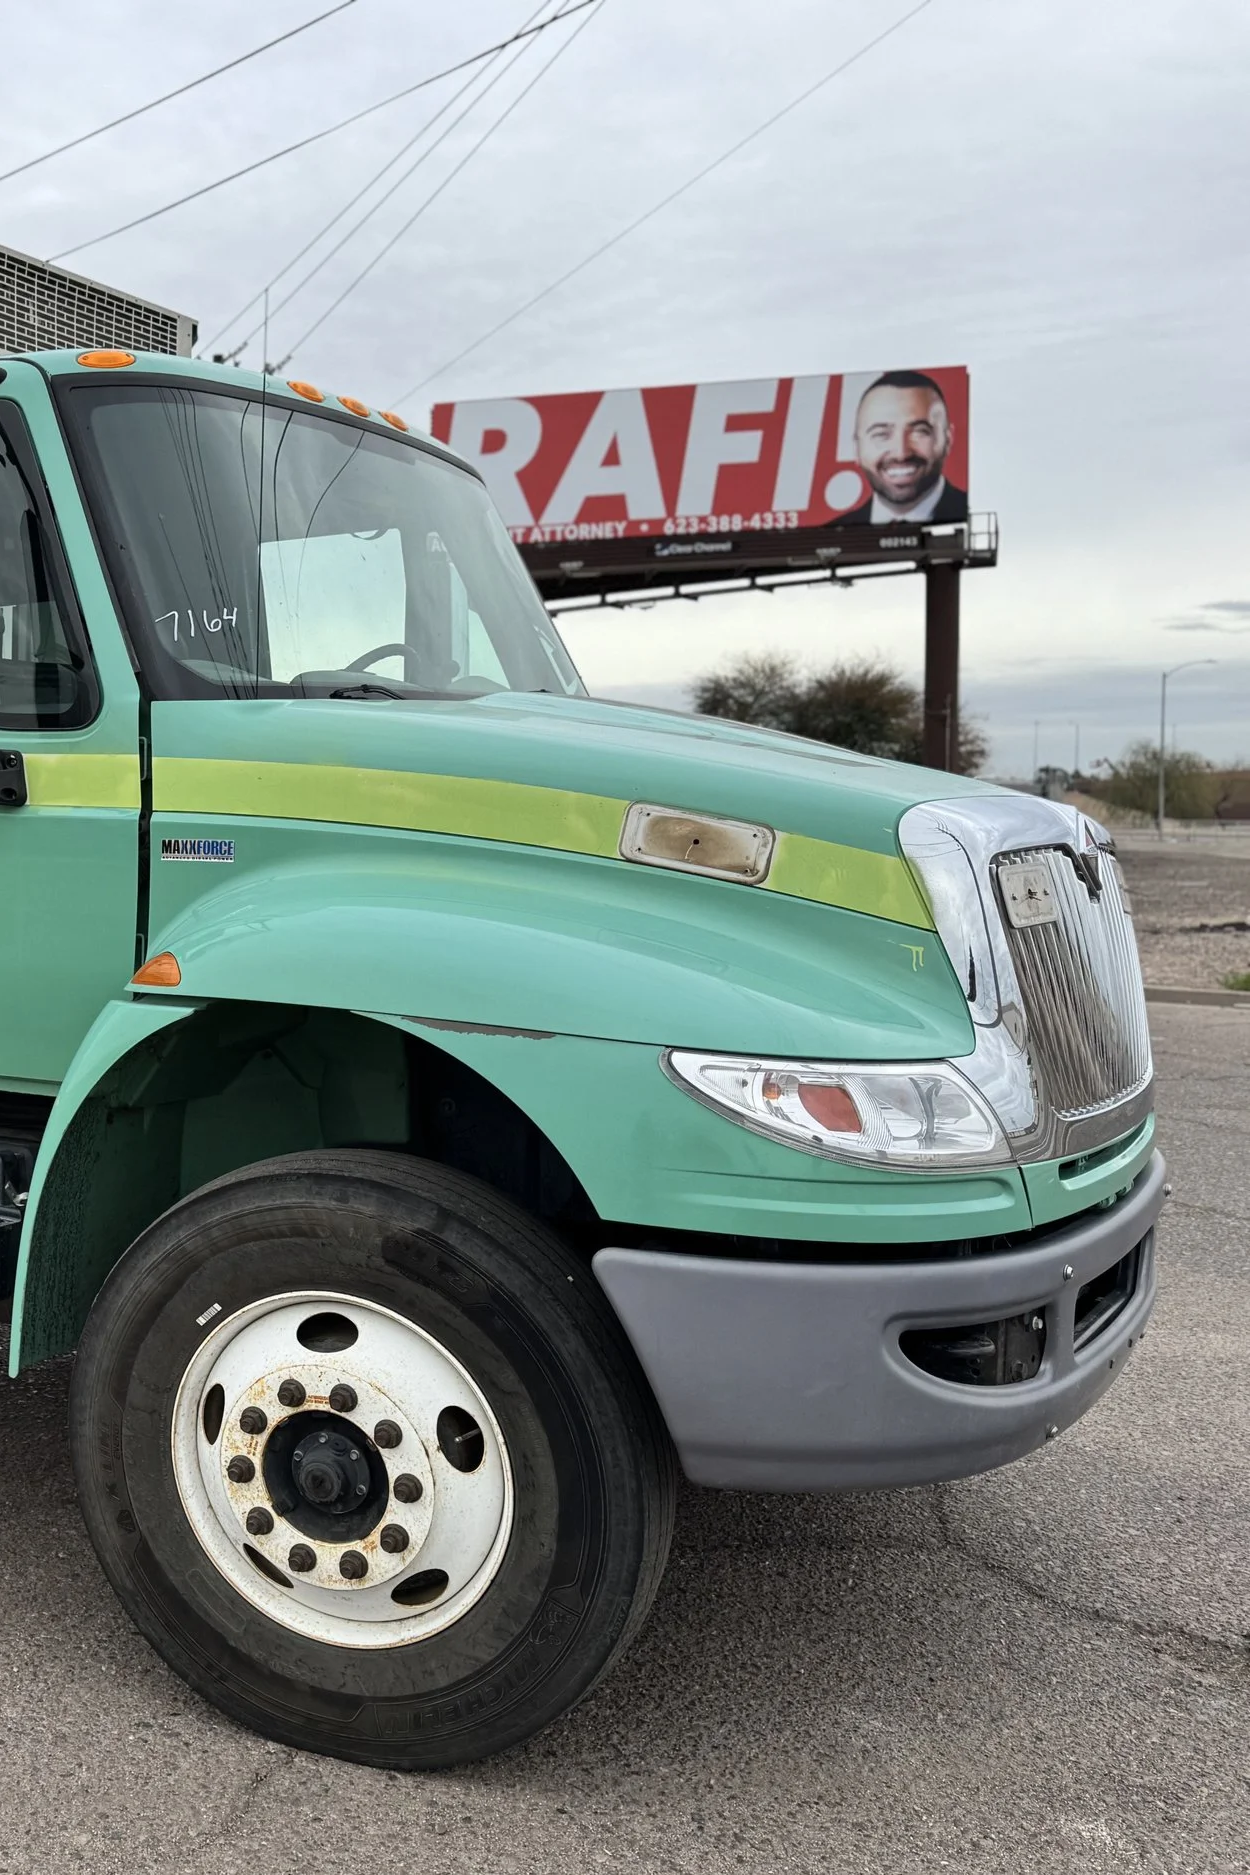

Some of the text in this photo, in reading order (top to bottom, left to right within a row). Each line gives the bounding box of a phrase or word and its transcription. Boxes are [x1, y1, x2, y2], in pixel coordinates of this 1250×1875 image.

[448, 371, 885, 526] RAFI!
[530, 521, 628, 543] ATTORNEY
[663, 511, 798, 536] 623-388-4333
[154, 607, 238, 642] 7164
[161, 839, 234, 856] MAXXFORCE
